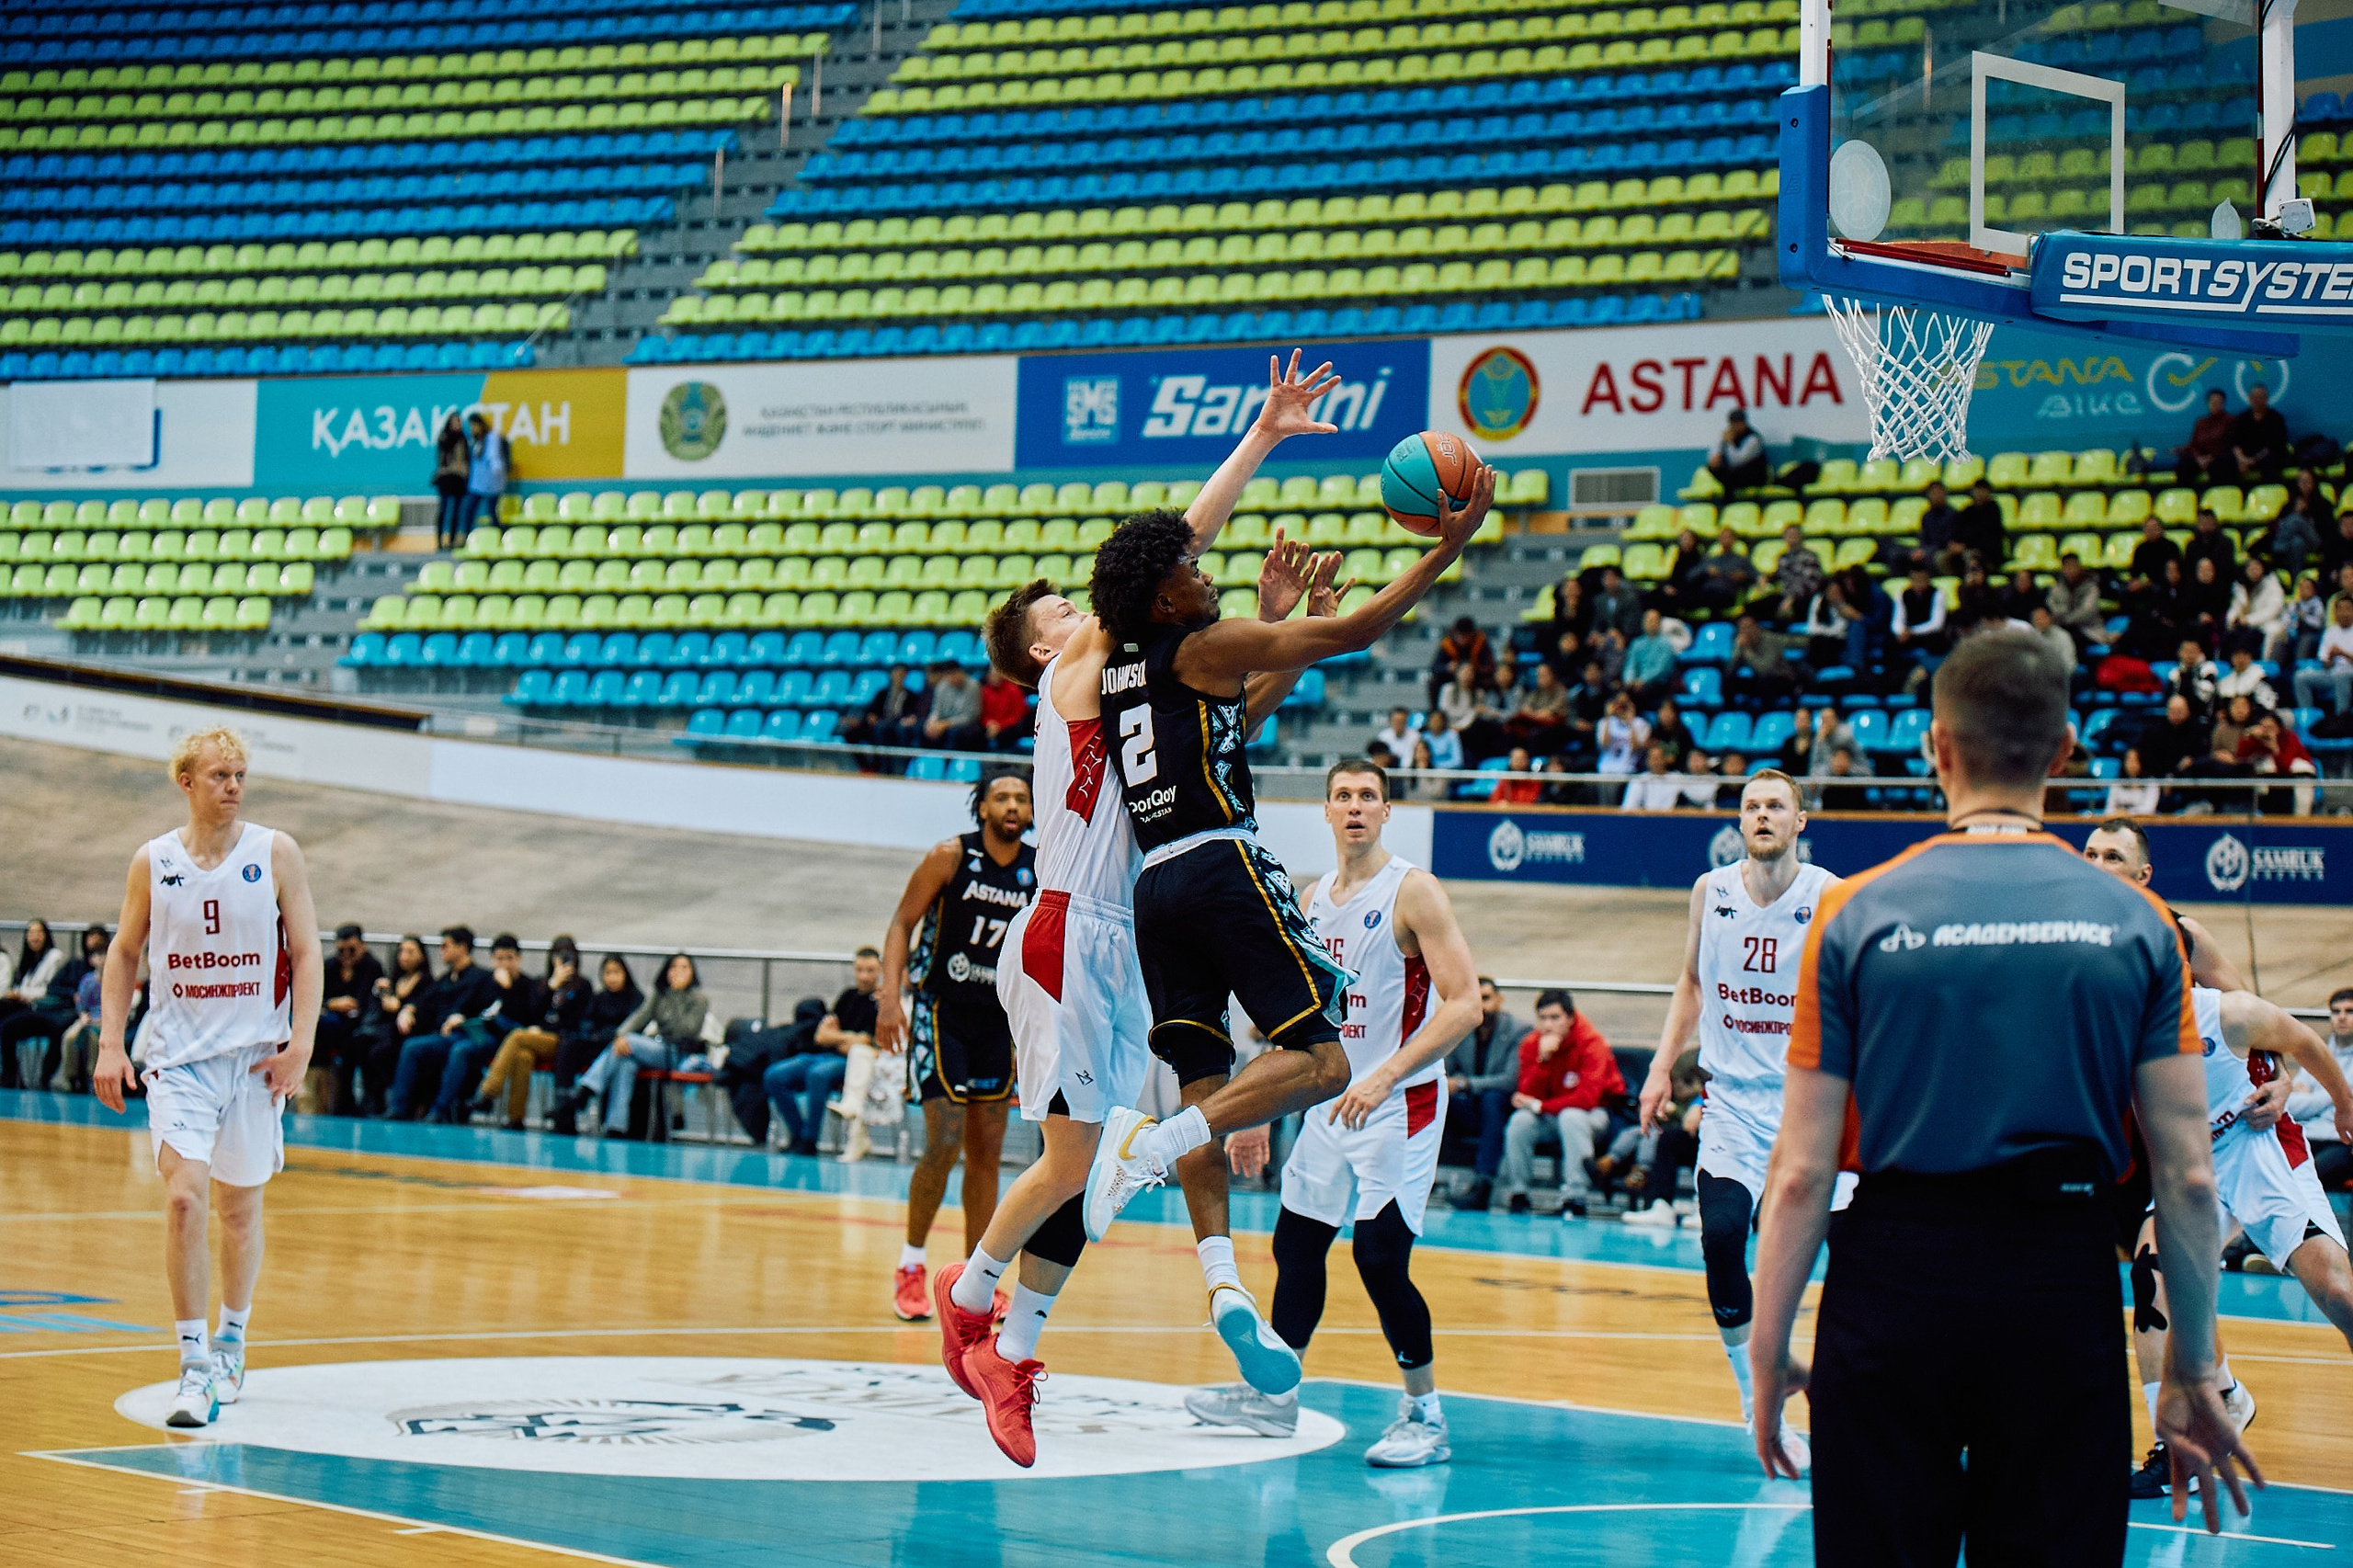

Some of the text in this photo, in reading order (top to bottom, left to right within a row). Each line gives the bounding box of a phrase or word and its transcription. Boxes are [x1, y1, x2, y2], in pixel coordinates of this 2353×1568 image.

[2063, 253, 2353, 312] SPORTSYSTE
[1581, 351, 1844, 415] ASTANA
[1101, 658, 1147, 695] JOHNSO
[1120, 702, 1157, 788] 2
[961, 880, 1029, 908] ASTANA
[203, 900, 221, 935] 9
[970, 915, 1008, 948] 17
[167, 952, 261, 970] BetBoom
[1743, 937, 1778, 973] 28
